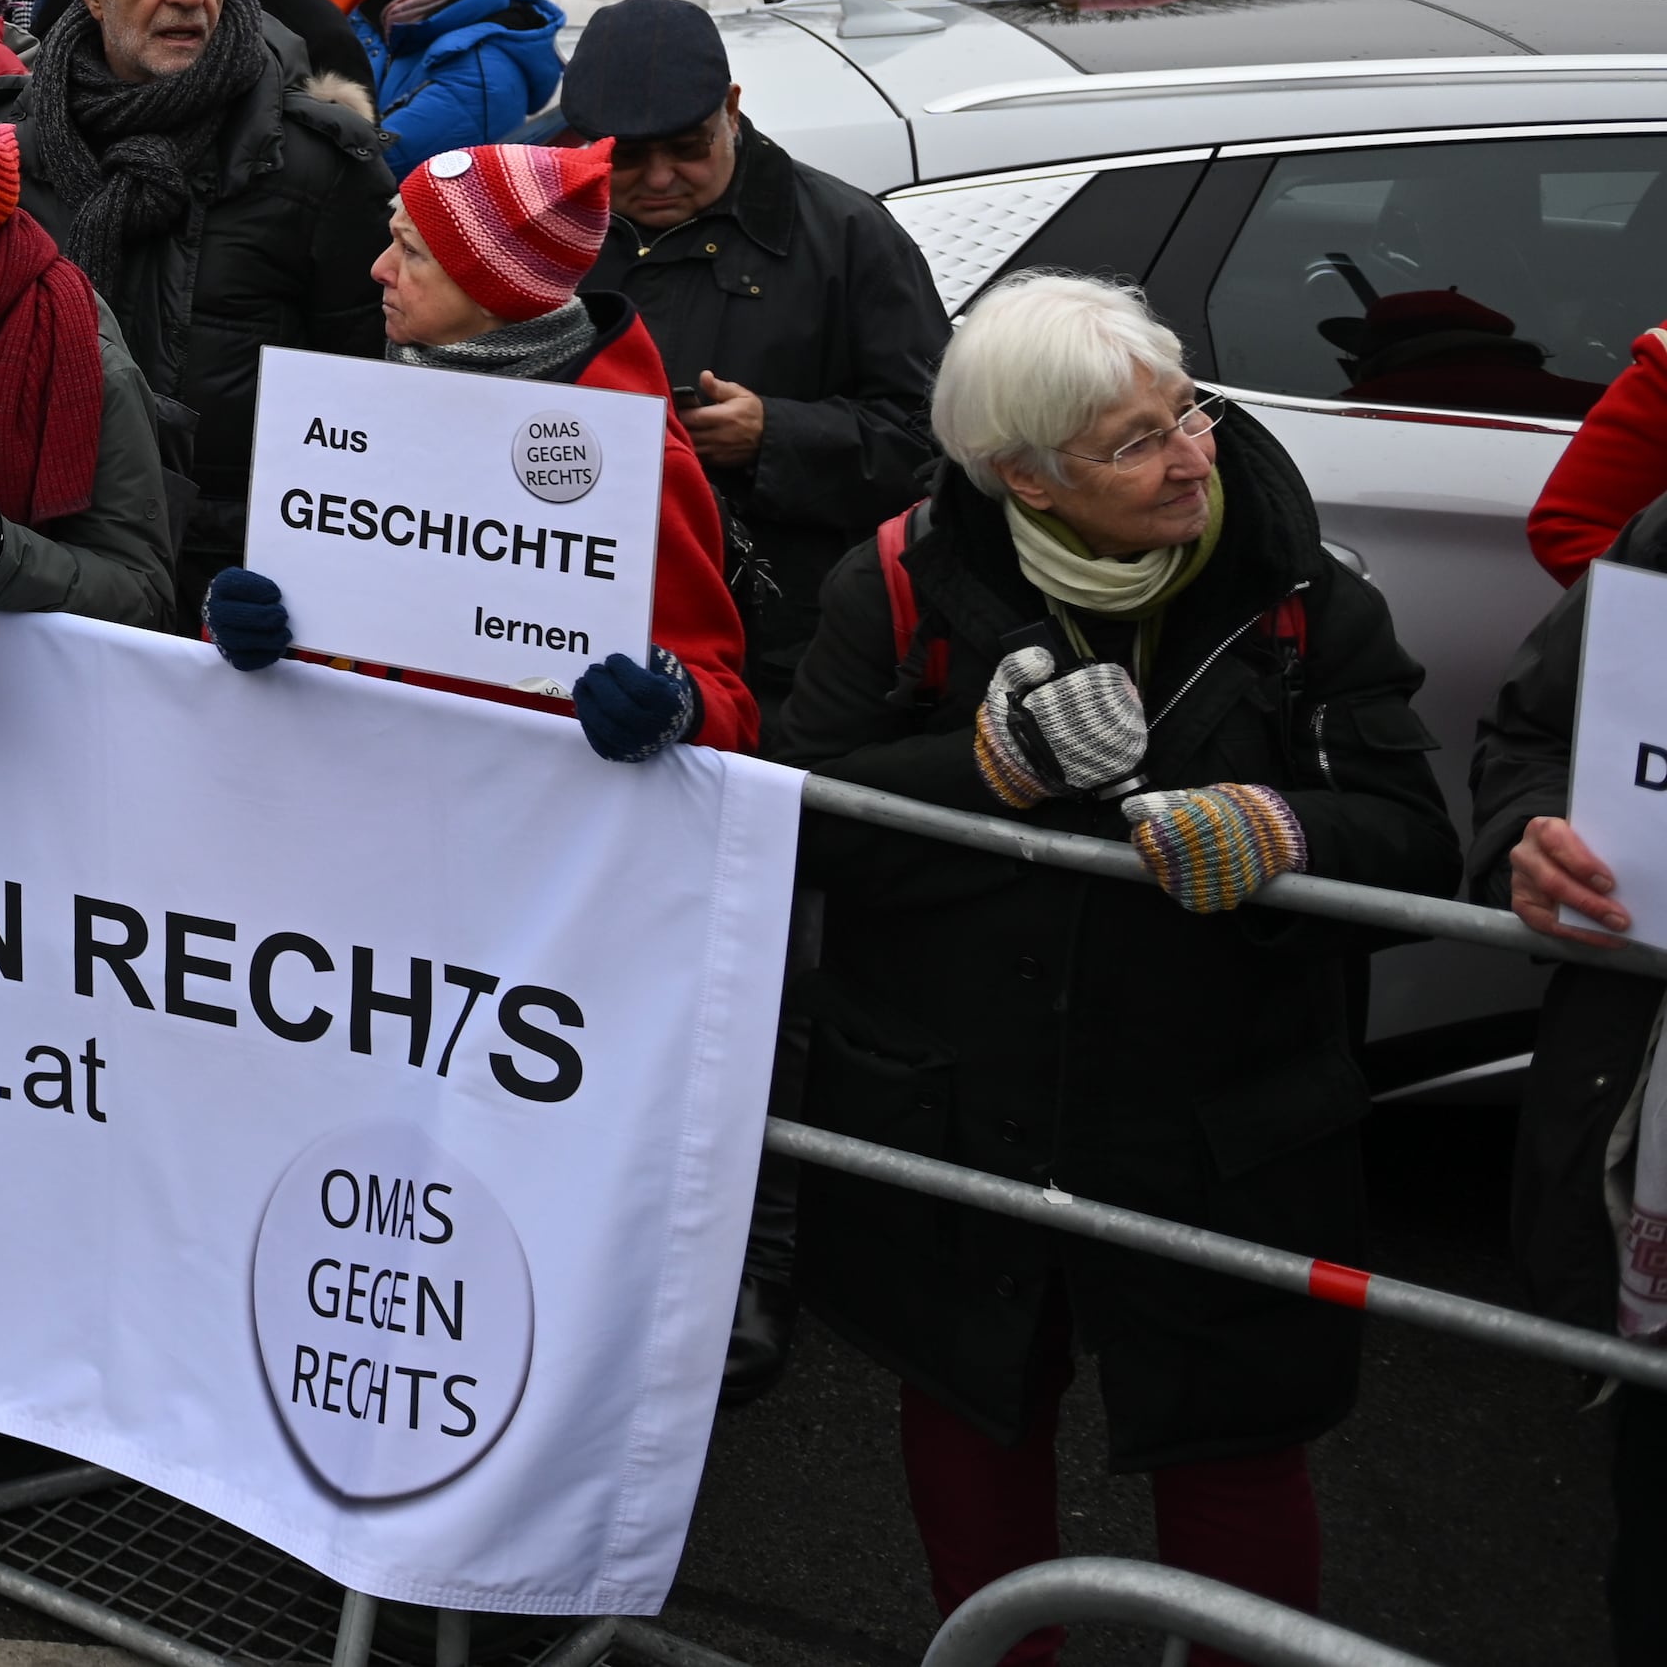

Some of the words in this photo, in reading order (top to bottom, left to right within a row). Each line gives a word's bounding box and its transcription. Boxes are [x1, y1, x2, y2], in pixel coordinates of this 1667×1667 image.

[302, 417, 369, 454] Aus
[526, 444, 588, 463] GEGEN
[529, 421, 580, 439] OMAS
[525, 469, 592, 486] RECHTS
[280, 487, 618, 582] GESCHICHTE
[473, 605, 590, 655] lernen
[72, 892, 586, 1105] RECHTS
[320, 1168, 454, 1245] OMAS
[308, 1257, 464, 1342] GEGEN
[292, 1344, 478, 1438] RECHTS
